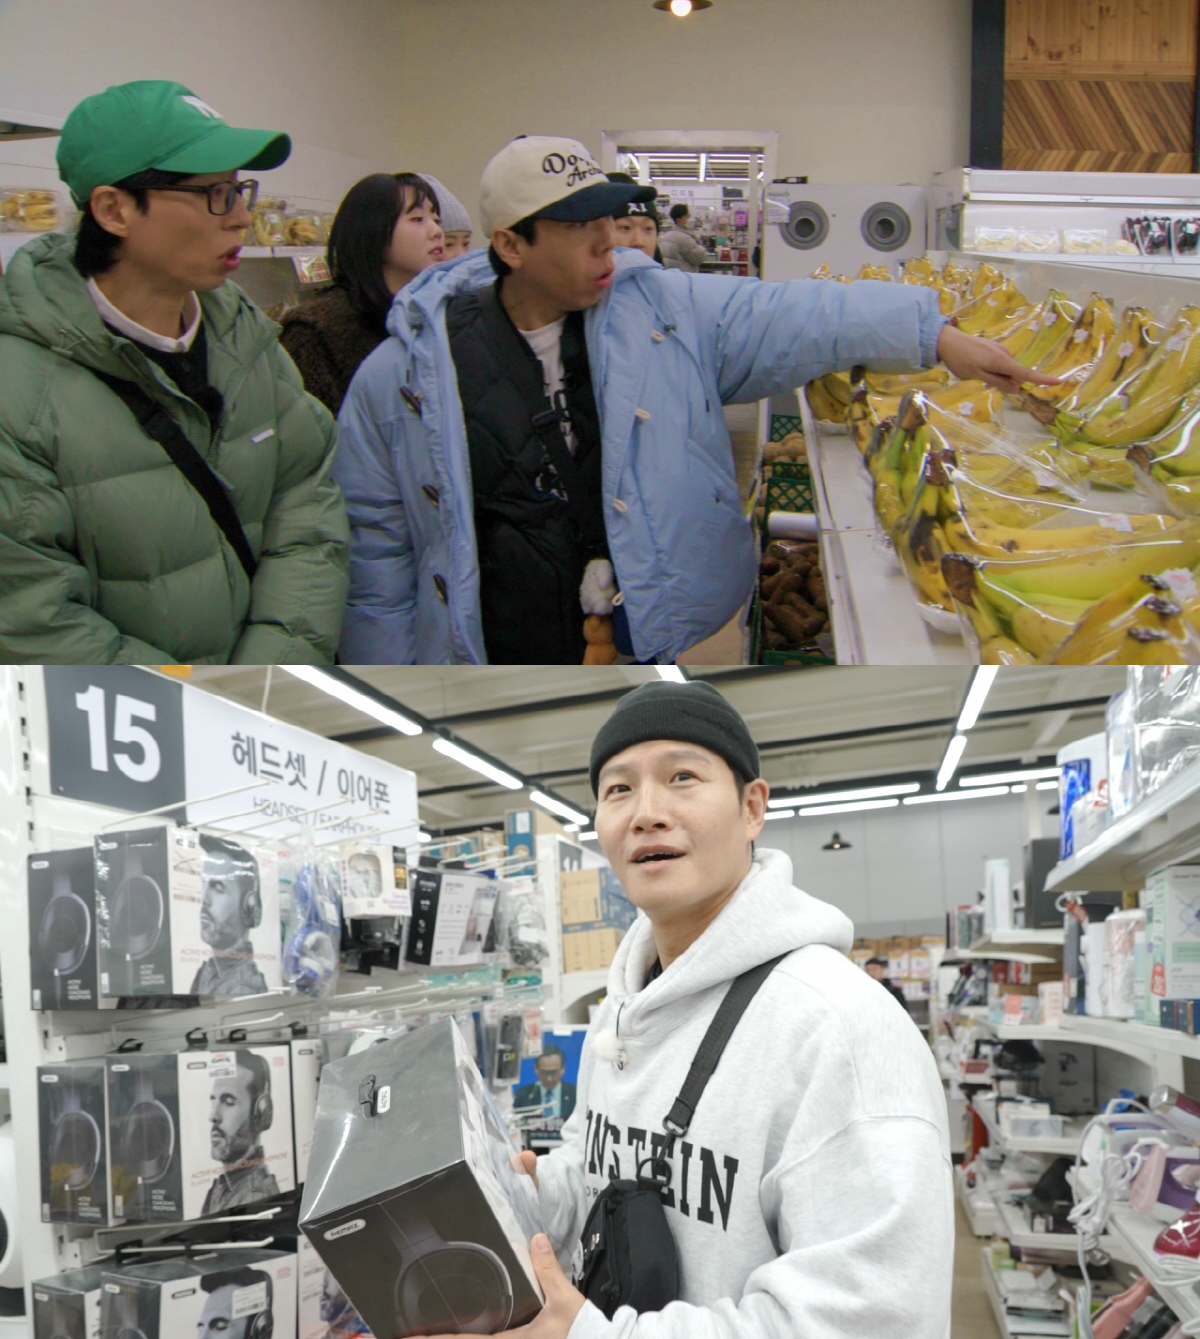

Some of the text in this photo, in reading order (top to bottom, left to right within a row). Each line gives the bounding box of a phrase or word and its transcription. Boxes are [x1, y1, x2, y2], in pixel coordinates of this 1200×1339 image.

[75, 684, 161, 783] 15
[231, 732, 307, 791] 헤드셋
[338, 769, 390, 815] 이어폰
